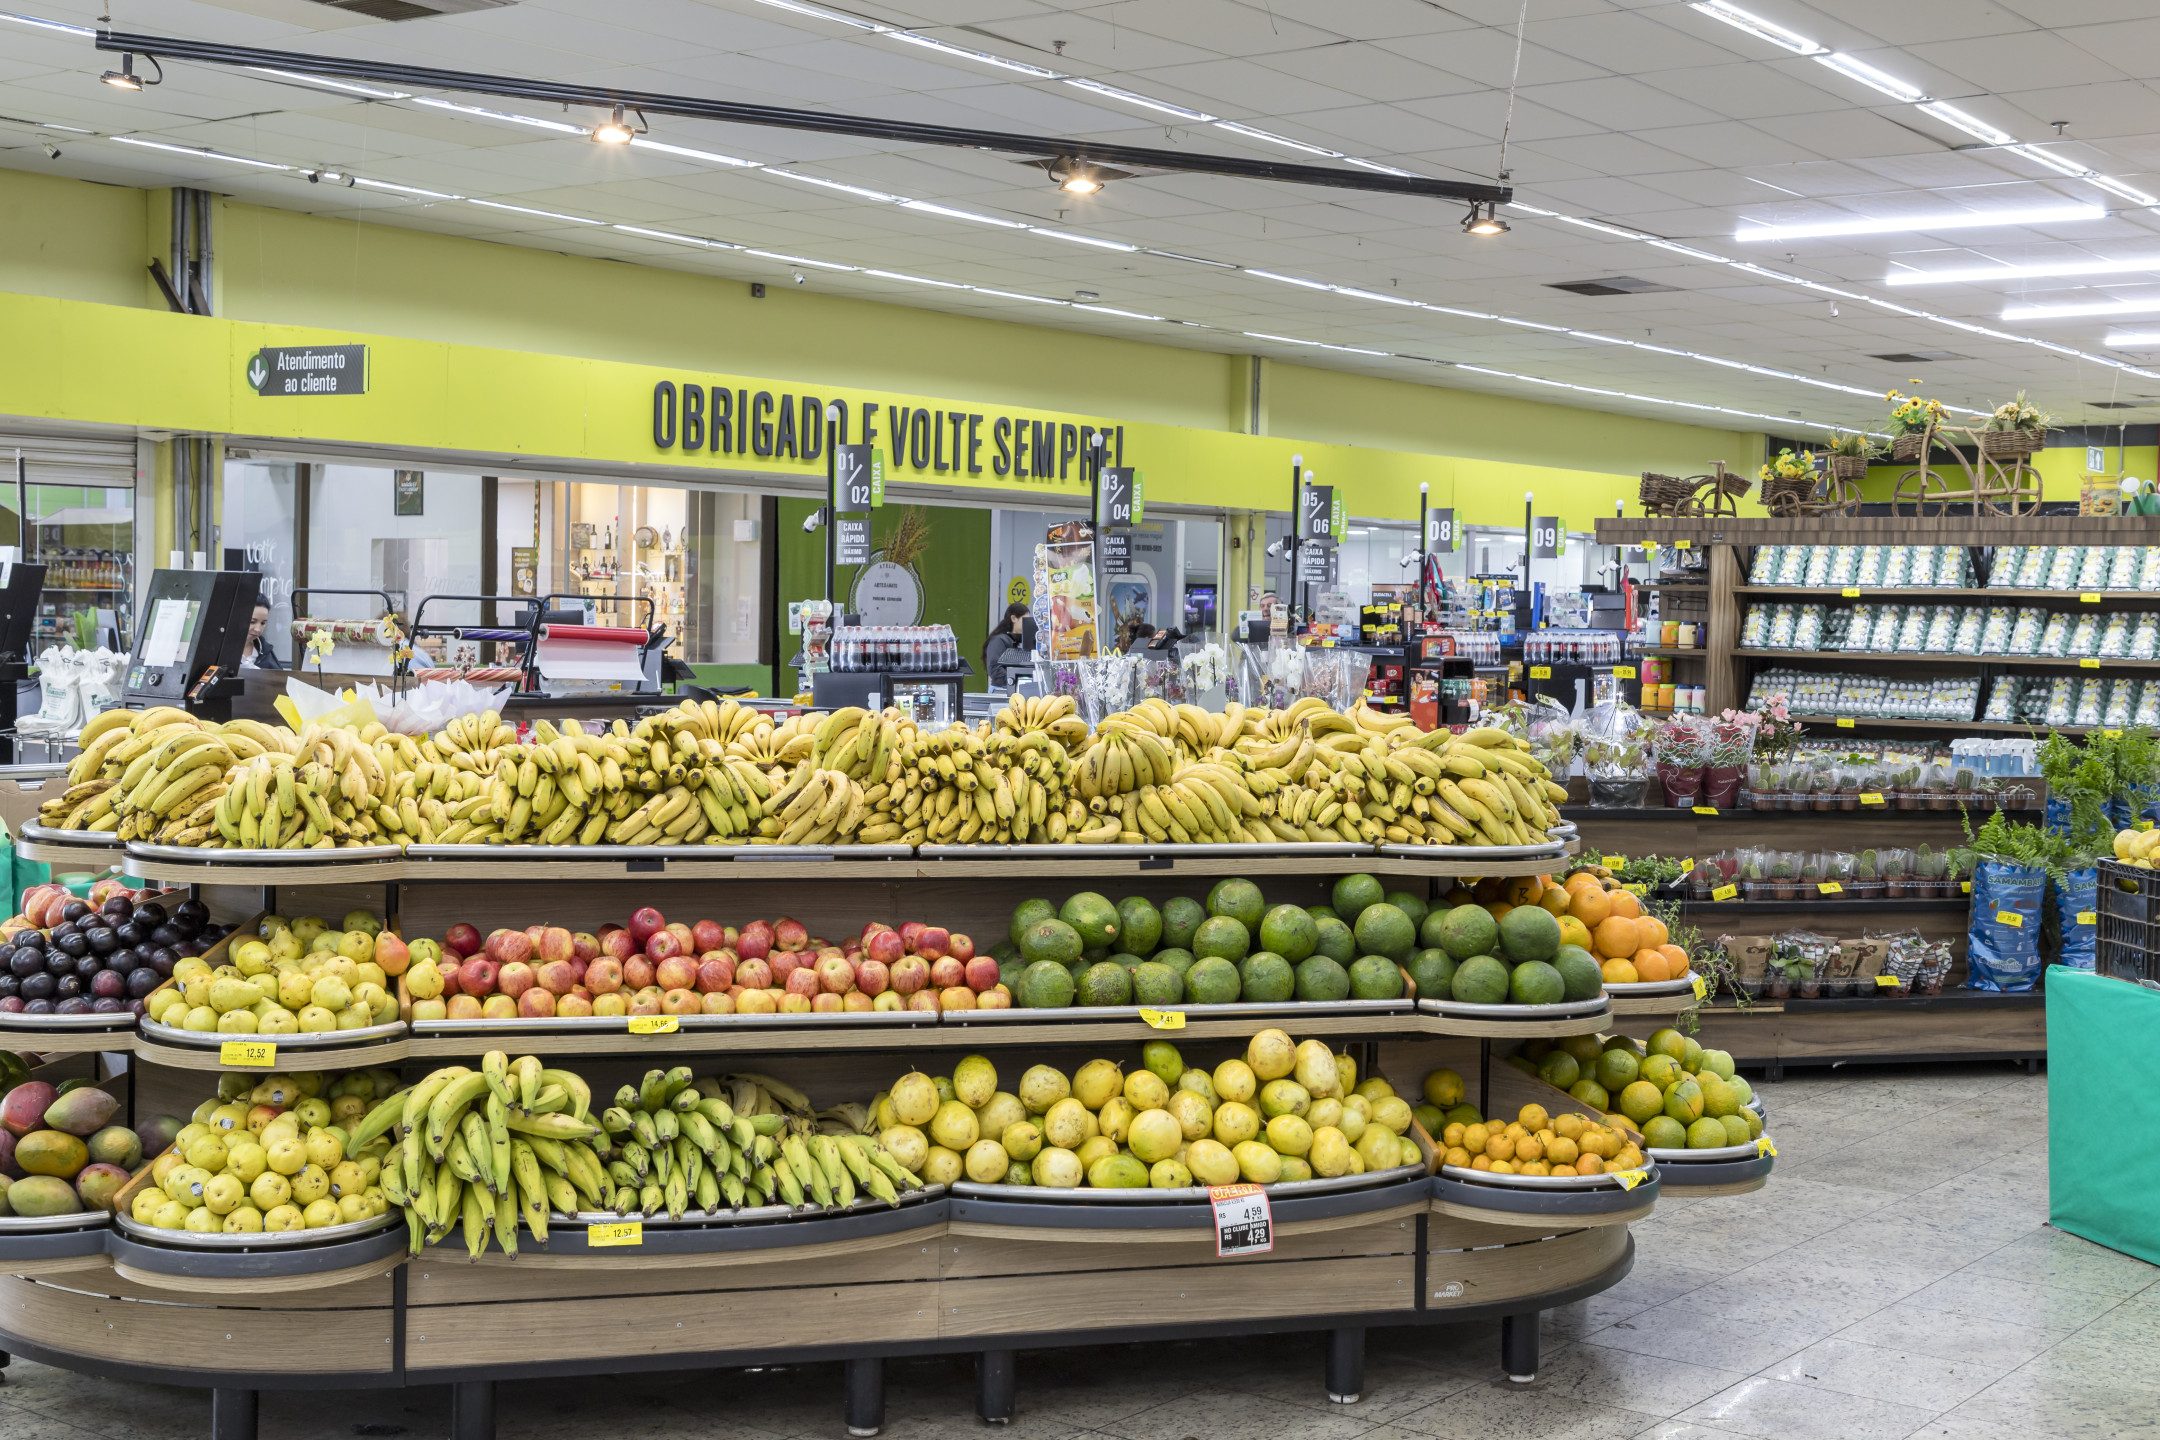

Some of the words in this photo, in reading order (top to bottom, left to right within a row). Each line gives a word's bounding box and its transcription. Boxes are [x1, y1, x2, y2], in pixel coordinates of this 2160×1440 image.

[277, 351, 346, 371] Atendimento
[285, 378, 297, 392] ao
[301, 372, 337, 392] cliente
[653, 380, 848, 460] OBRIGADO
[889, 405, 984, 473] VOLTE
[992, 416, 1124, 481] SEMPRE!
[838, 452, 854, 471] 01
[872, 462, 881, 494] CAIXA
[1101, 474, 1118, 491] 03
[851, 485, 869, 504] 02
[1133, 483, 1142, 512] CAIXA
[1302, 492, 1318, 507] 05
[1113, 503, 1130, 520] 04
[1332, 499, 1340, 526] CAIXA
[843, 522, 863, 532] CAIXA
[1313, 518, 1329, 534] 06
[1429, 520, 1451, 541] 08
[841, 532, 865, 543] RÁPIDO
[1105, 537, 1125, 545] CAIXA
[1534, 527, 1555, 548] 09
[1557, 527, 1565, 548] CAIXA
[1103, 545, 1127, 556] RÁPIDO
[1304, 548, 1324, 556] CAIXA
[1302, 556, 1325, 566] RÁPIDO
[1011, 588, 1027, 597] CVC
[246, 1048, 266, 1058] 12,52
[1211, 1184, 1262, 1200] OFERTA
[613, 1228, 632, 1238] 12,57
[1232, 1224, 1249, 1232] CLUBE
